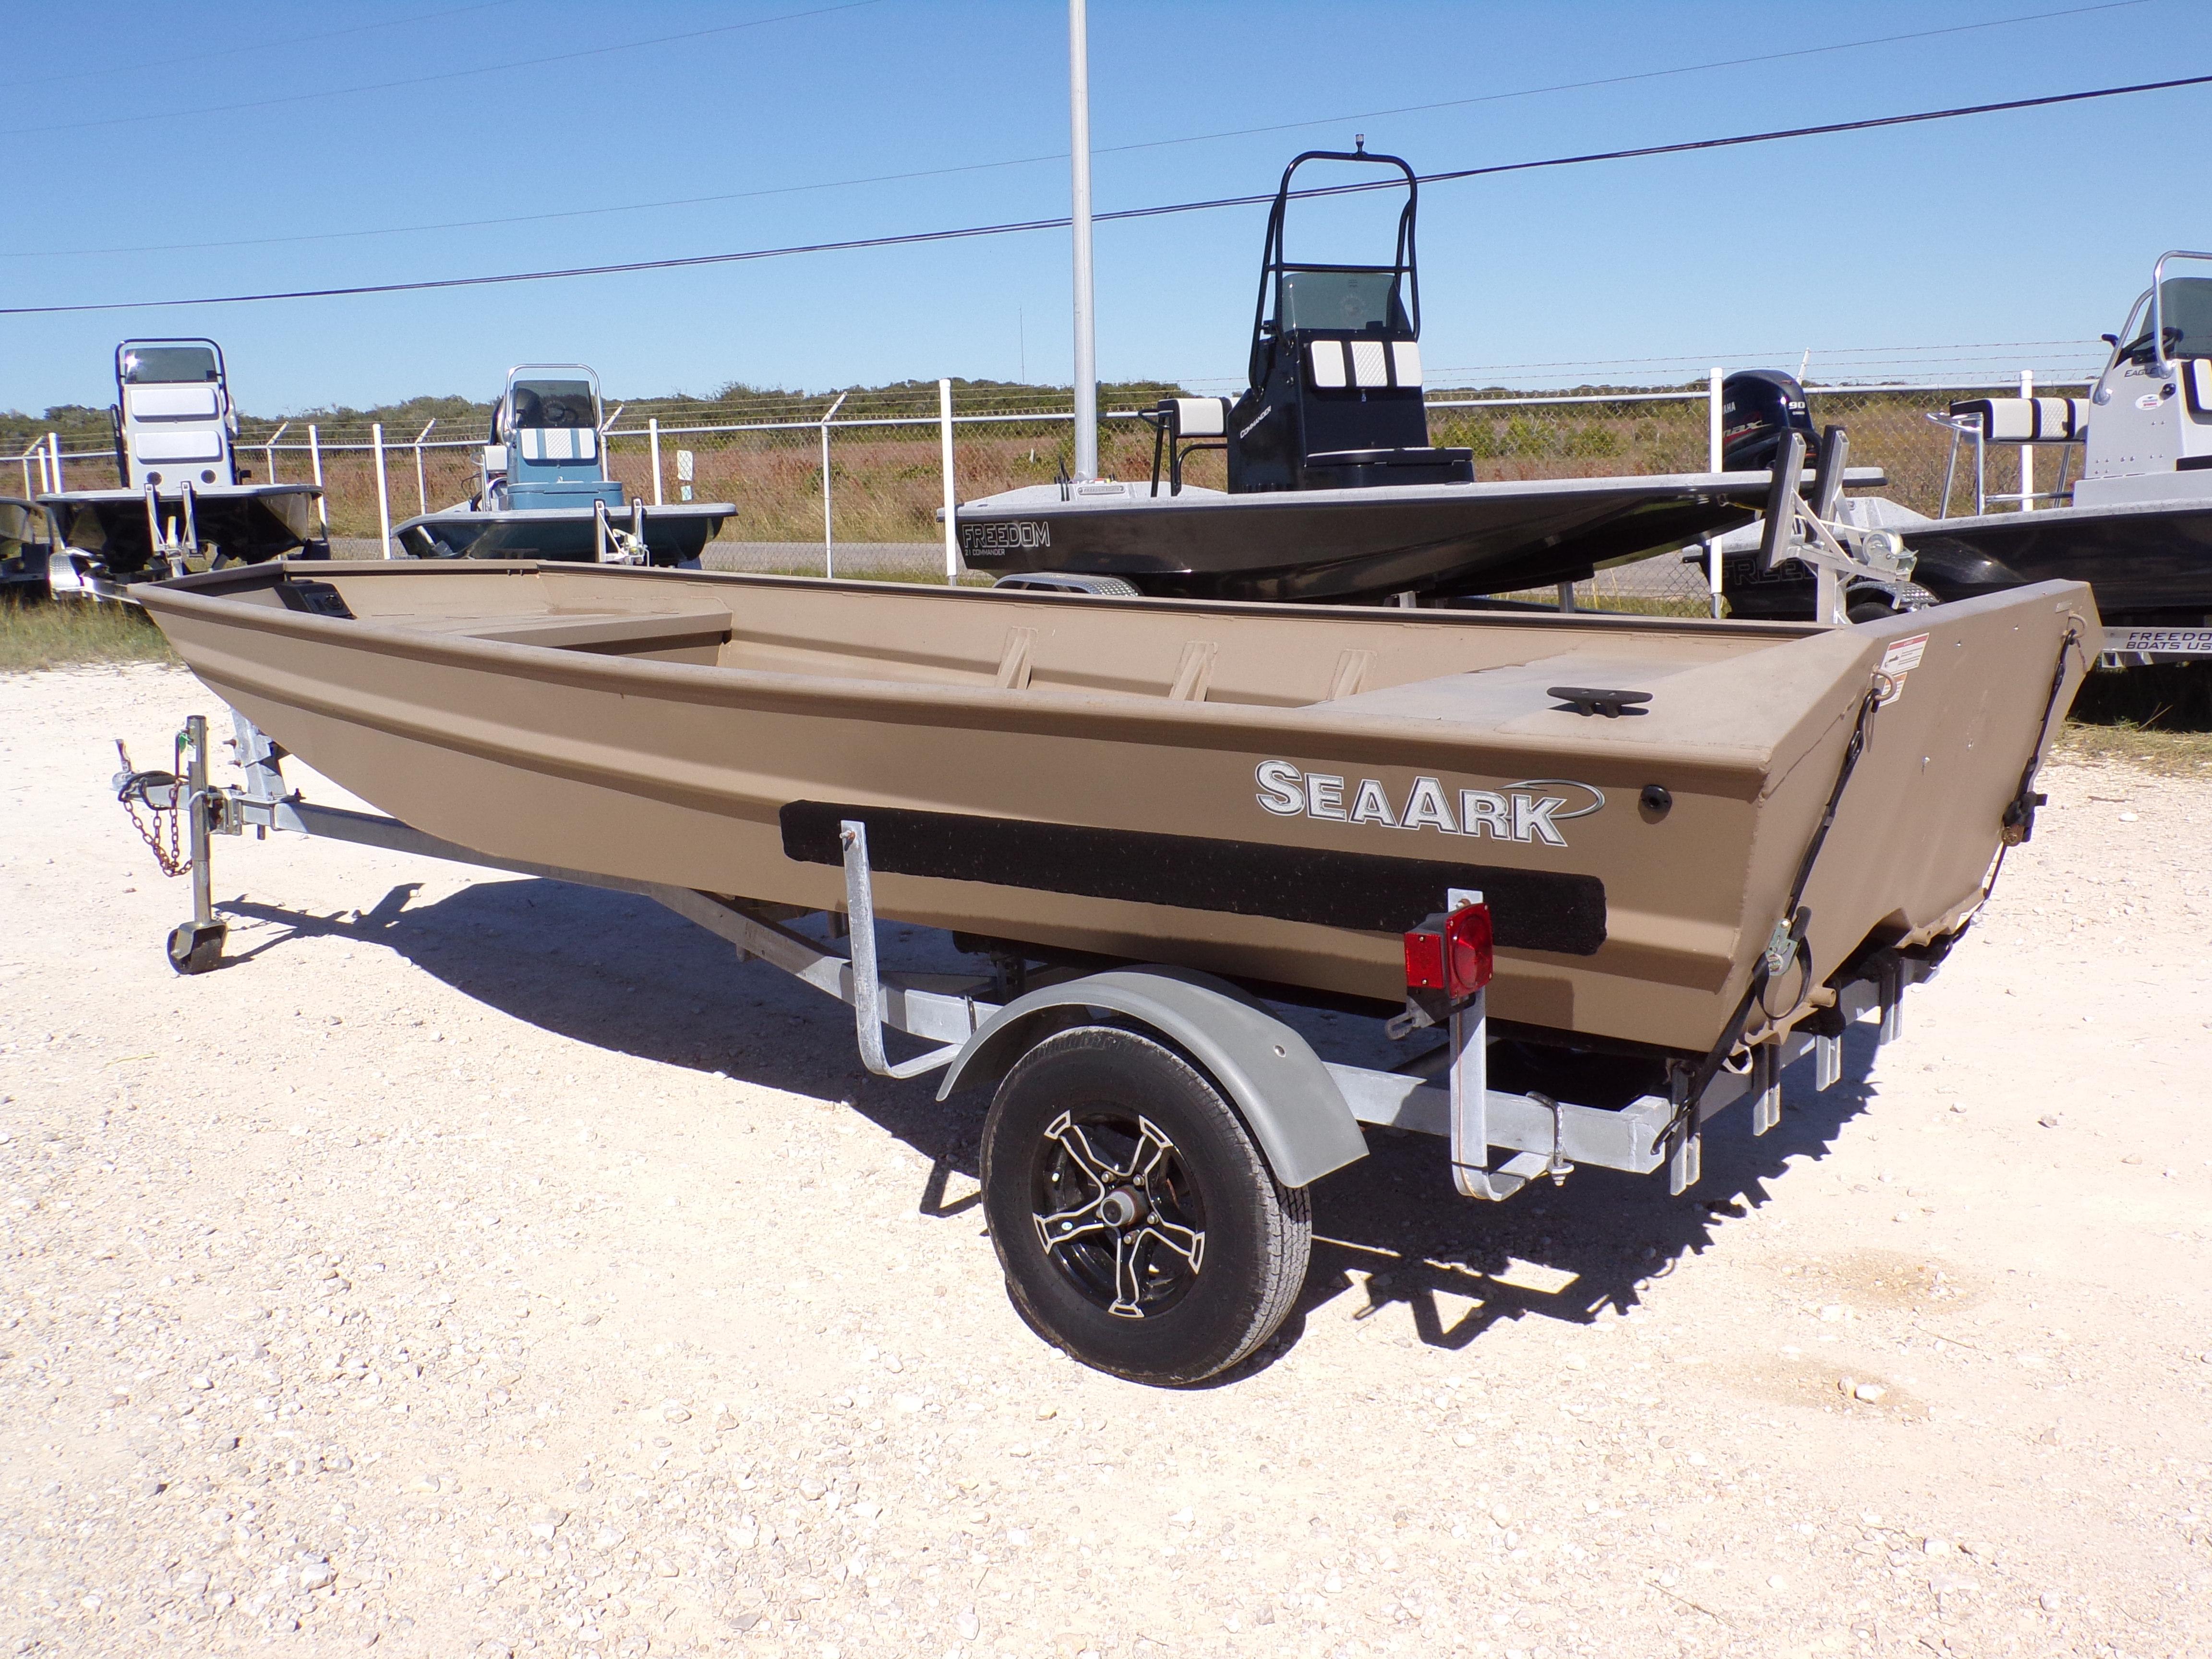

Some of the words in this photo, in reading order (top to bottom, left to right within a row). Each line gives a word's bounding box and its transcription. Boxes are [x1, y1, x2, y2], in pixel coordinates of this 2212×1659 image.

[2124, 368, 2158, 377] EAGLE
[1723, 401, 1736, 415] AHA
[1789, 401, 1805, 409] 90
[962, 521, 1050, 548] FREEDOM
[2129, 632, 2212, 641] FREEDO
[2126, 641, 2181, 649] BOATS
[2187, 642, 2212, 650] US
